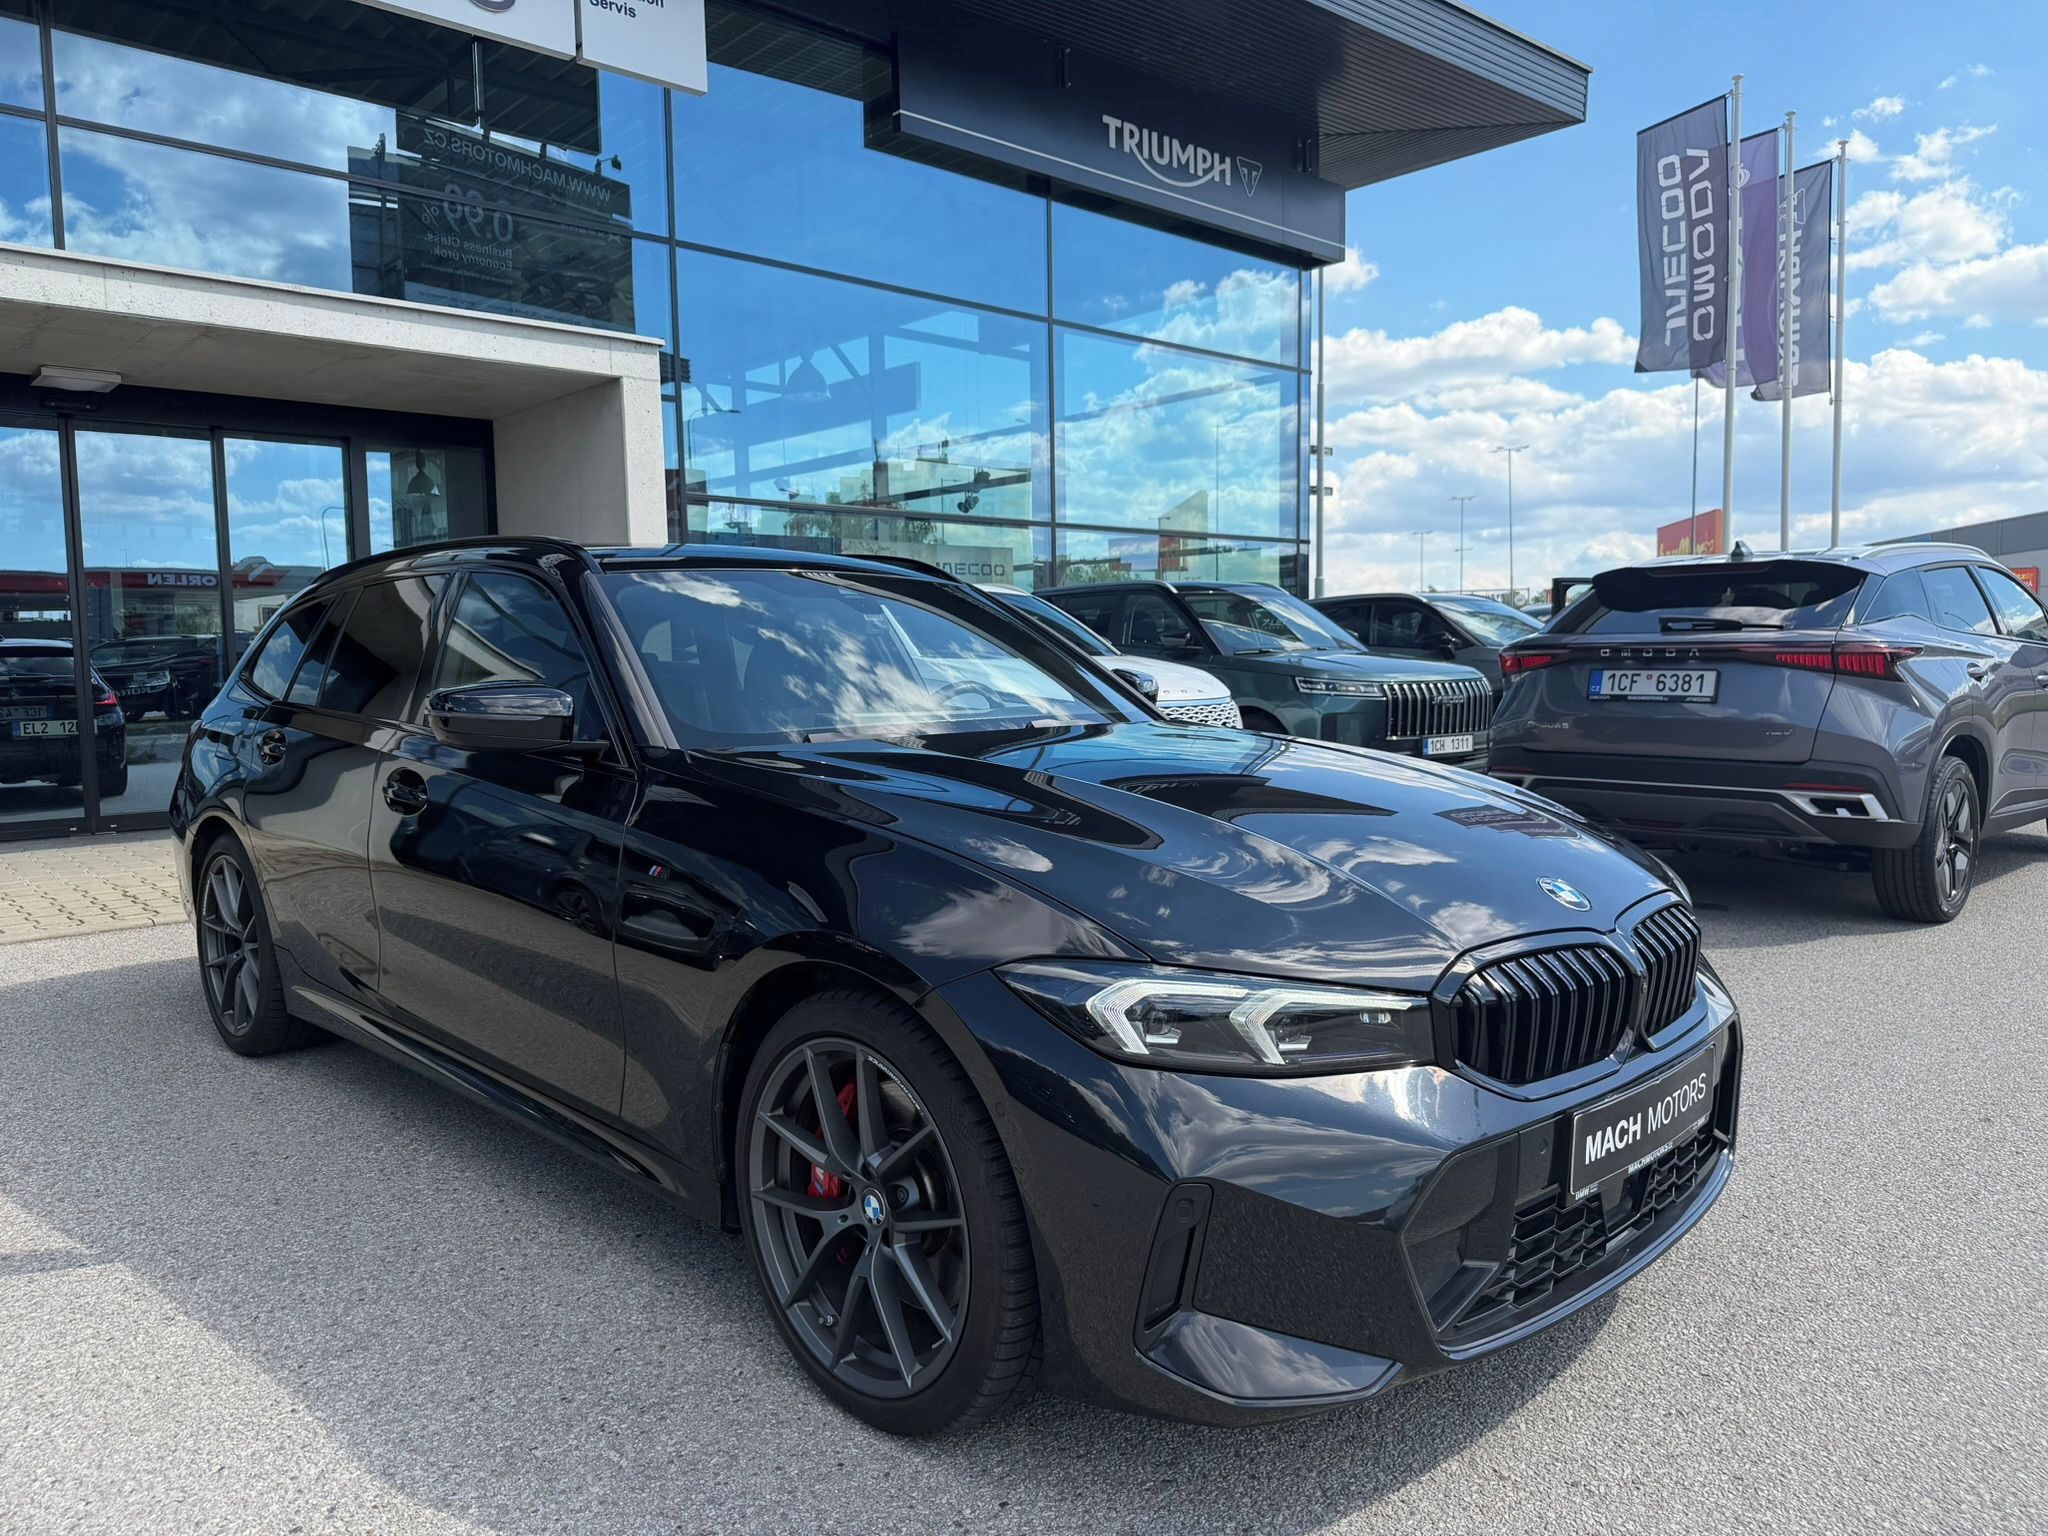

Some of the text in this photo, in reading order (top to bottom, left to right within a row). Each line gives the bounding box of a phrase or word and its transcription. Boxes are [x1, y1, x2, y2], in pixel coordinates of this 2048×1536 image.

[1102, 115, 1231, 187] TRIUMPH
[936, 562, 1005, 577] AECOO
[1607, 673, 1641, 692] 1CF
[1655, 673, 1705, 693] 6381
[23, 721, 78, 734] EL2 12
[1430, 737, 1469, 752] 1CH 1311
[1585, 1072, 1706, 1165] MACH MOTORS
[1575, 1187, 1589, 1200] BMW
